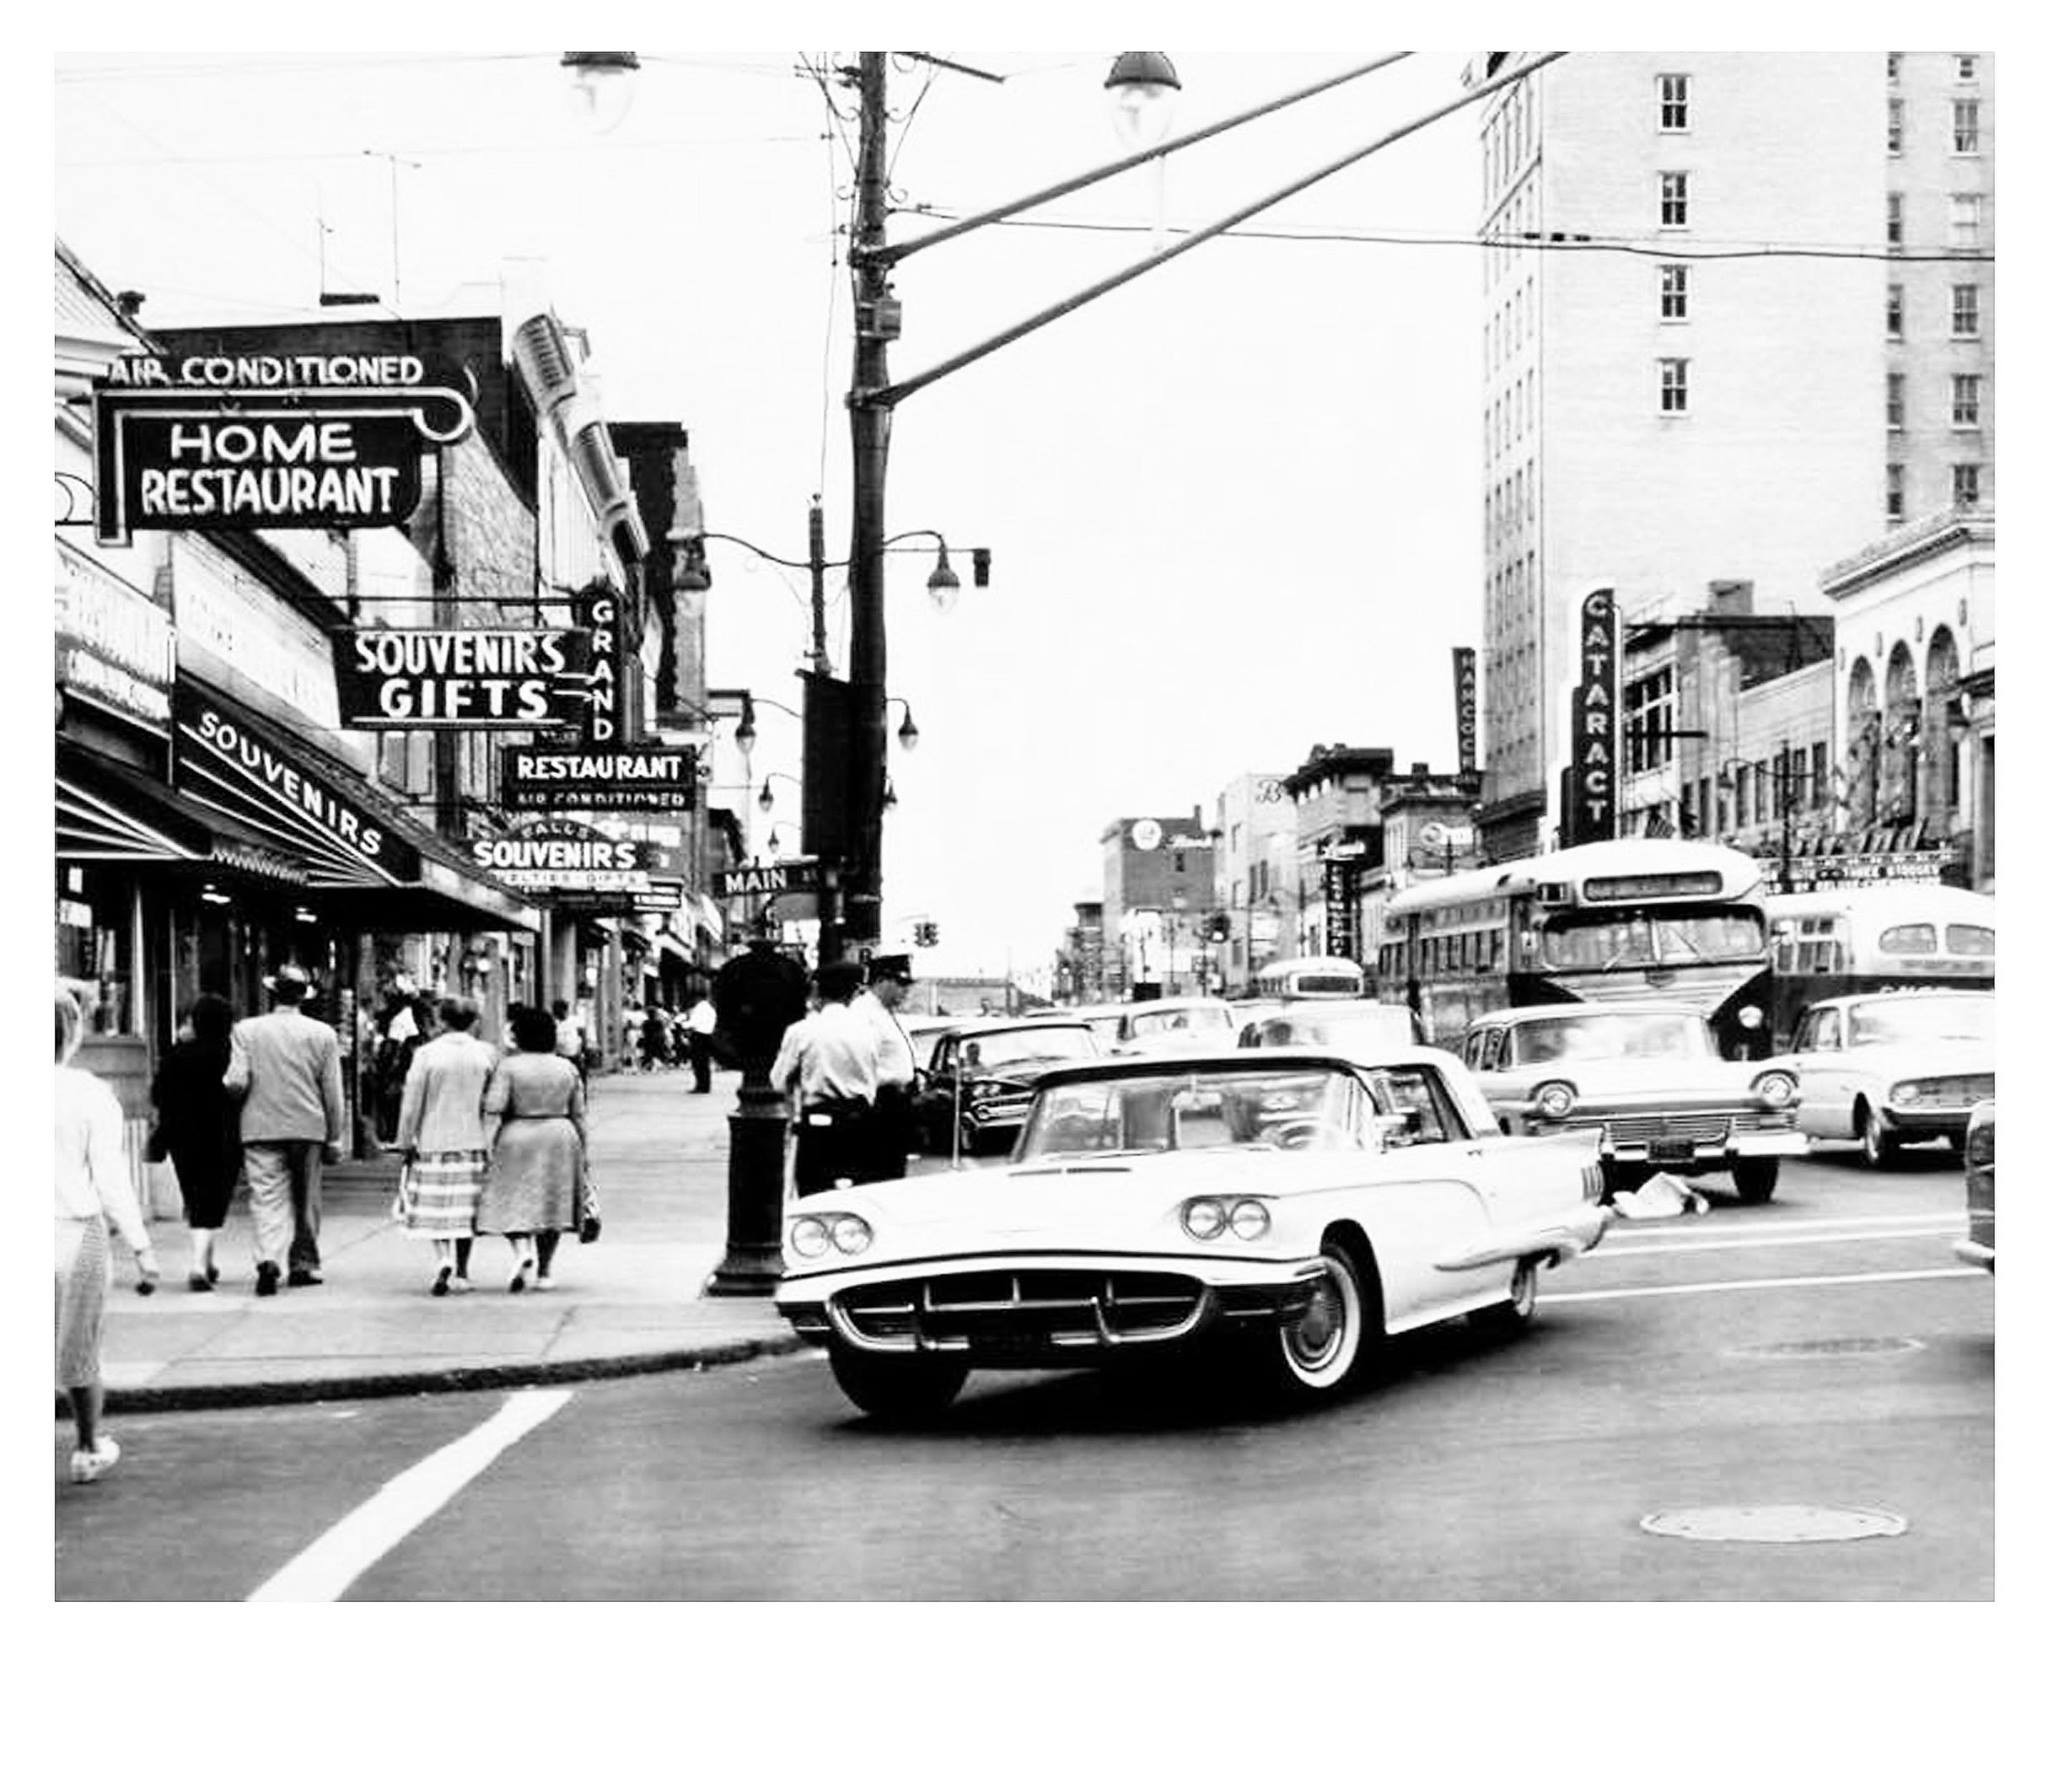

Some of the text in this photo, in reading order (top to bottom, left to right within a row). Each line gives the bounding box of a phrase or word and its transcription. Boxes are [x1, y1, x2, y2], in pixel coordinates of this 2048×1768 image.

[107, 355, 424, 386] AIR CONDITIONED
[170, 422, 357, 463] HOME
[141, 467, 399, 515] RESTAURANT
[355, 633, 566, 675] SOUVENIRS
[591, 600, 614, 742] GRAND
[379, 678, 549, 720] GIFTS
[1585, 595, 1610, 822] CATARACT
[199, 711, 382, 855] SOUVENIRS
[517, 755, 683, 780] RESTAURANT
[554, 791, 685, 807] CONDITIONED
[473, 840, 637, 869] SOUVENIRS
[724, 868, 788, 893] MAIN
